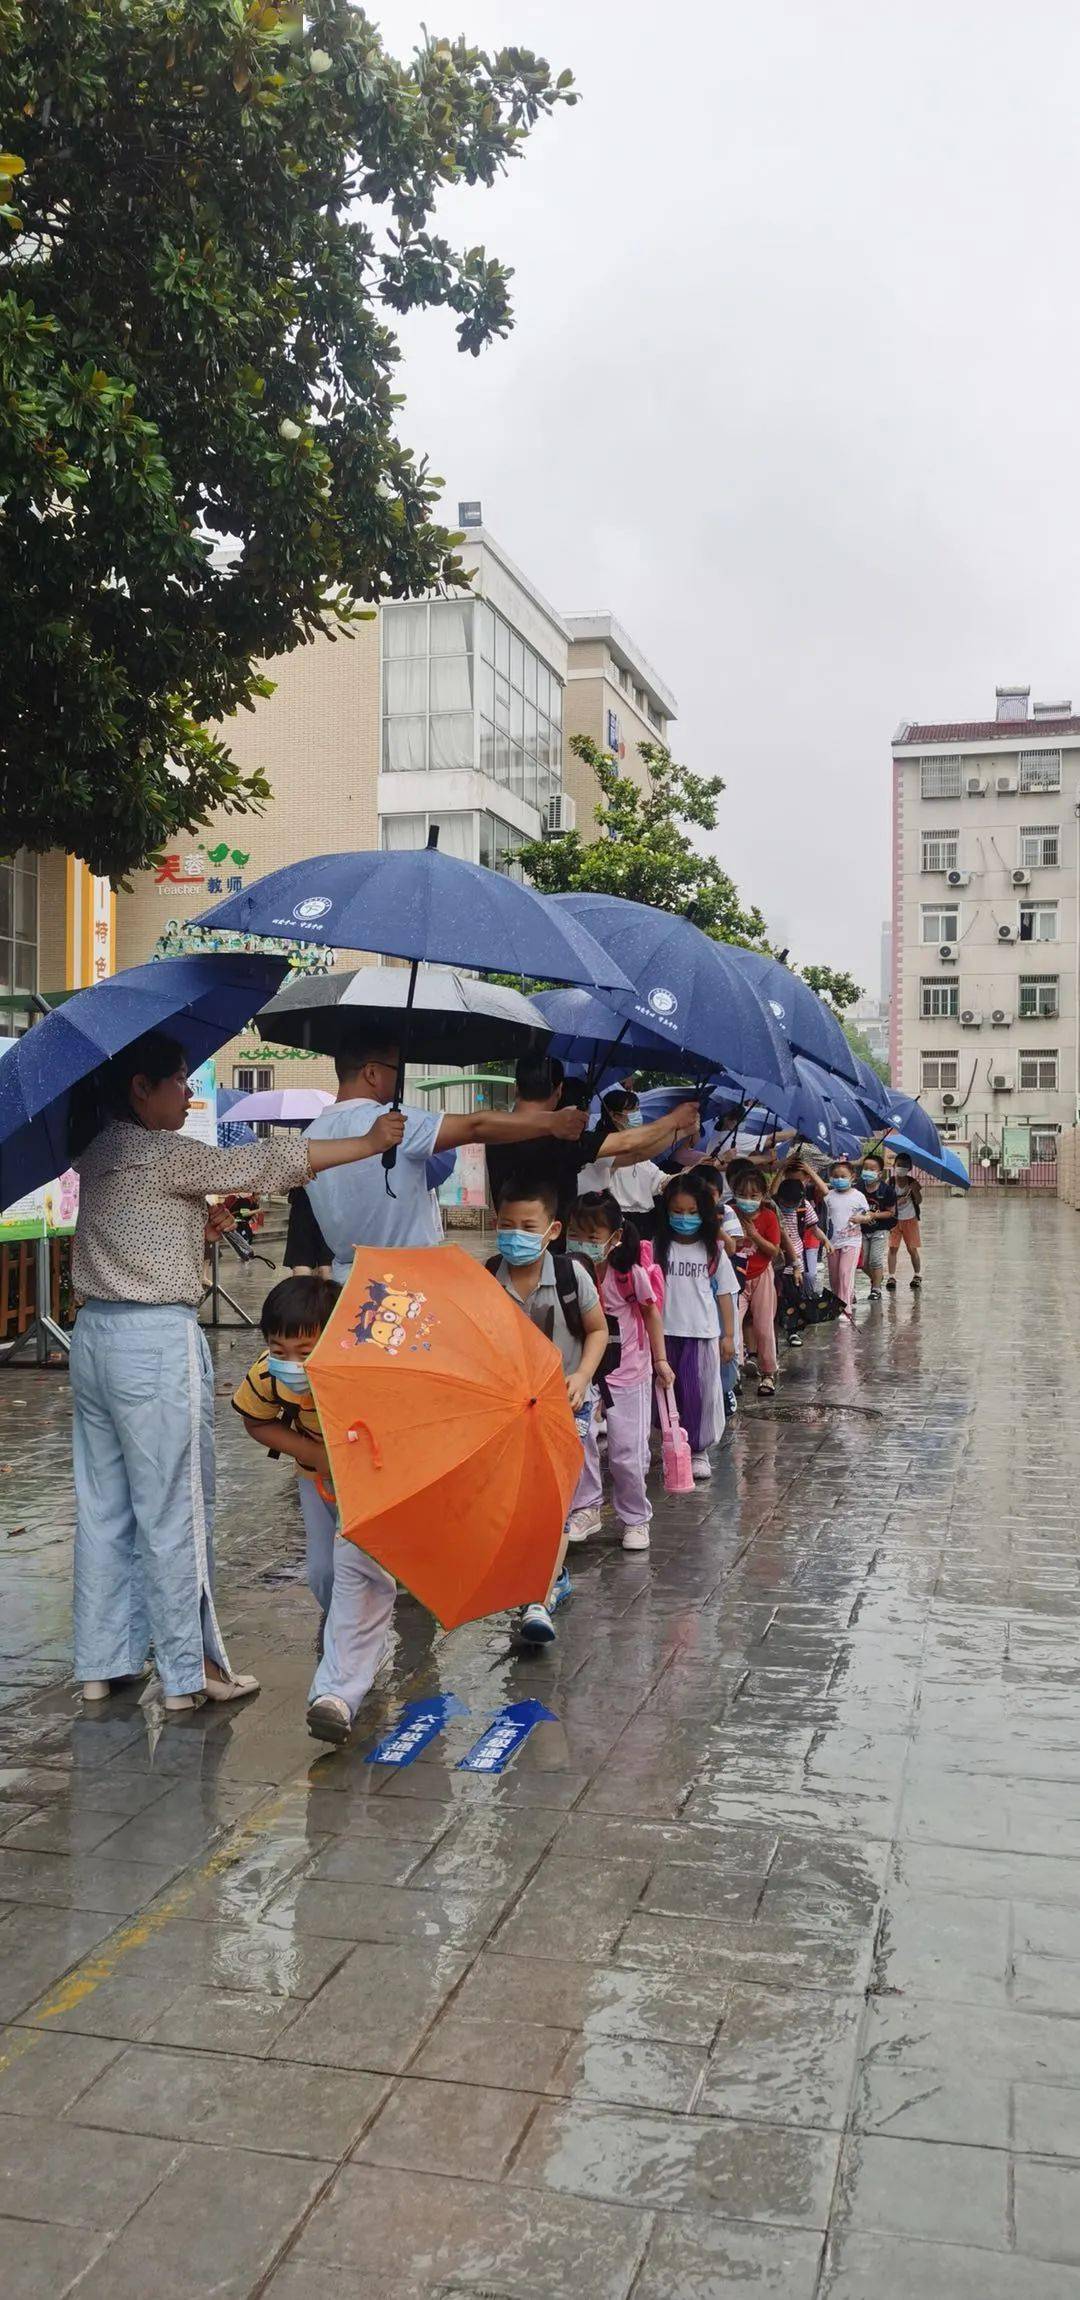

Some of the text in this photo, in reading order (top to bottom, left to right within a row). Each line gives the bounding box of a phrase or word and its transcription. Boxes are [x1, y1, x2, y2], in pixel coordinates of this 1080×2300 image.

[157, 884, 202, 896] Teacher
[207, 876, 242, 894] 教师
[377, 1714, 440, 1762] 六年级通道
[469, 1722, 526, 1769] 一年级通道
